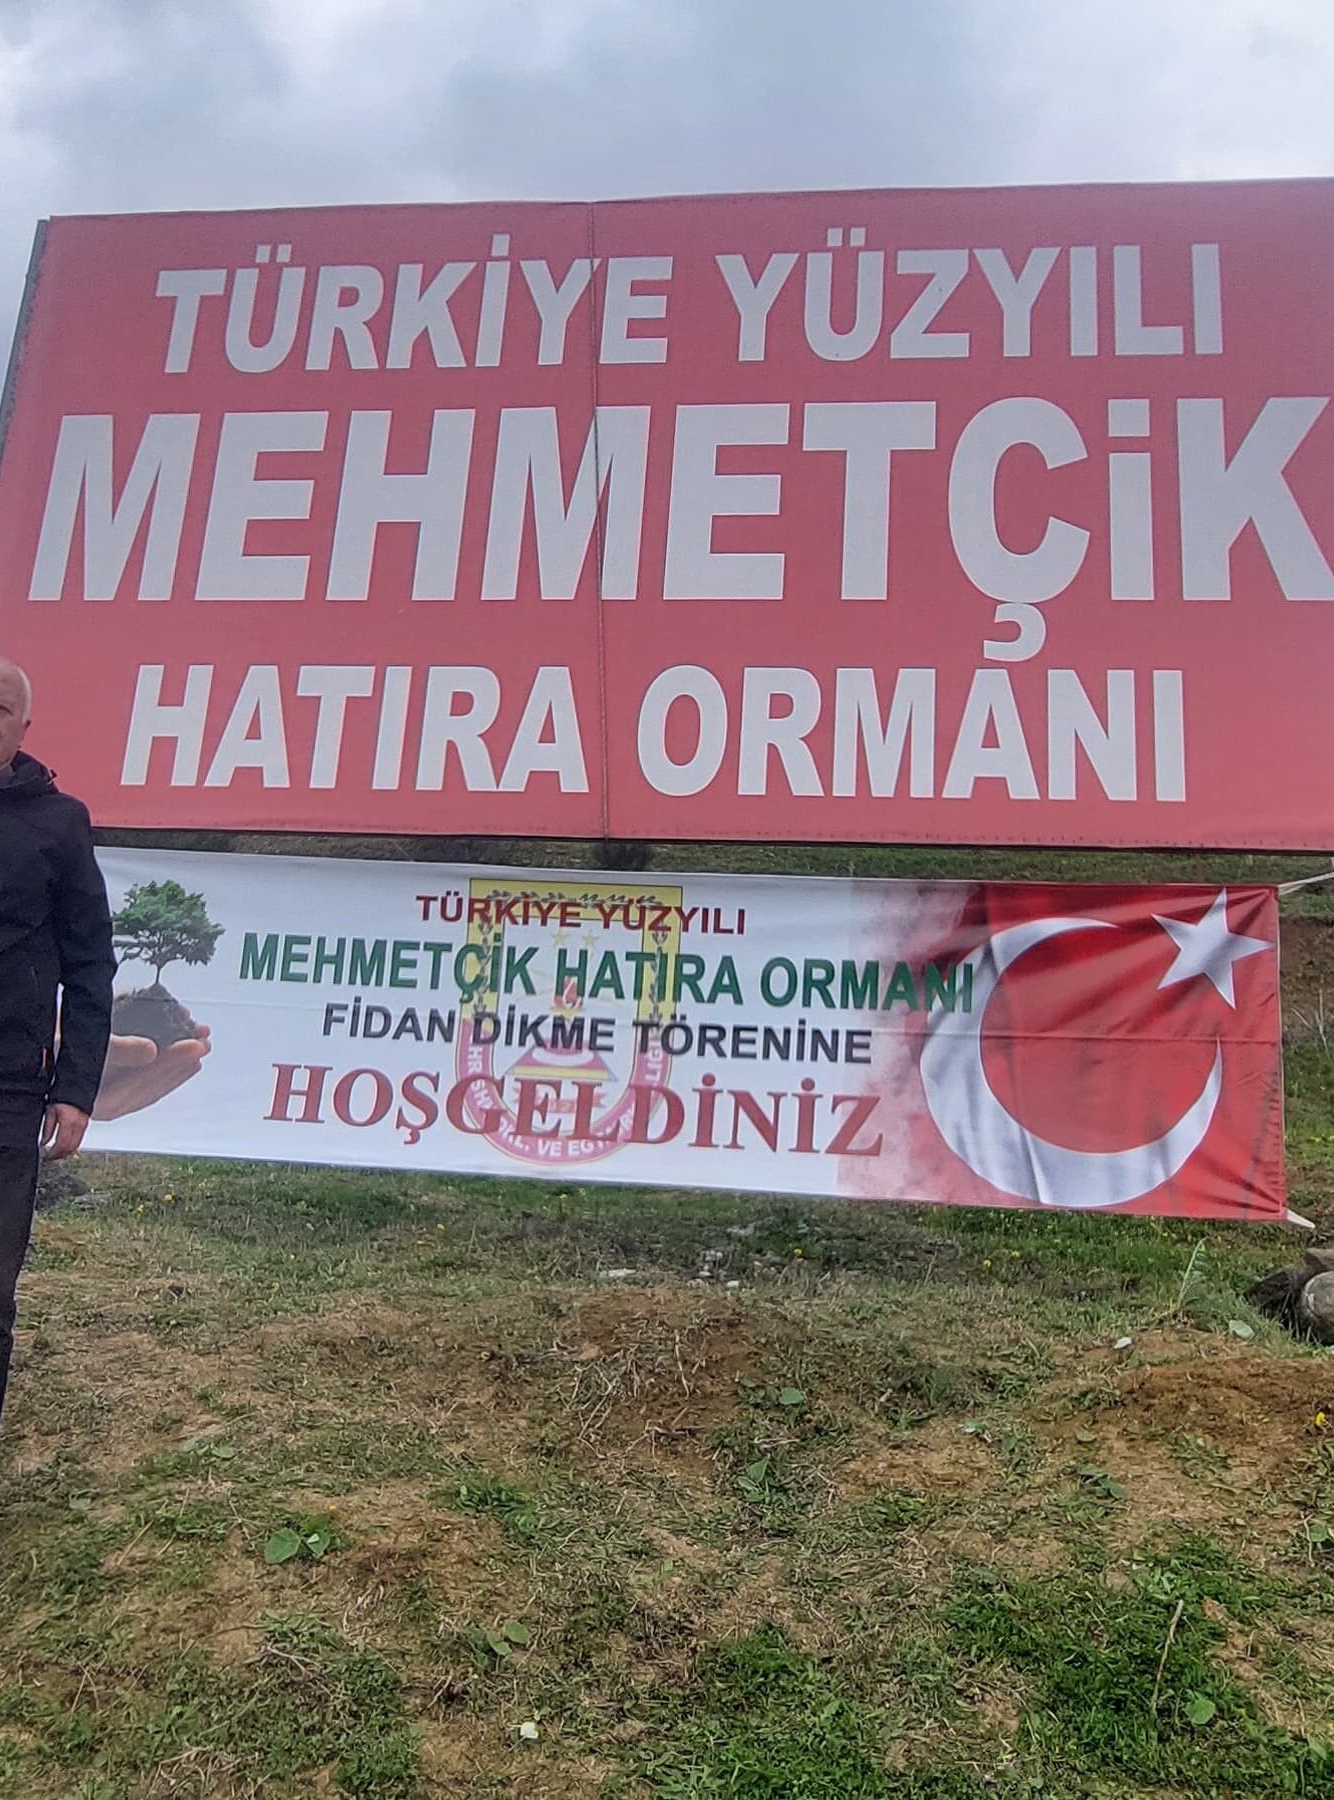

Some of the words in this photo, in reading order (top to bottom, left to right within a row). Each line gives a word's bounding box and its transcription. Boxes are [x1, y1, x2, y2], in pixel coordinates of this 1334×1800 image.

[155, 233, 673, 373] TÜRKİYE
[715, 226, 1224, 362] YÜZYILI
[119, 664, 590, 793] HATIRA
[636, 665, 1187, 802] ORMANI
[416, 890, 582, 928] TÜRKİYE
[596, 898, 746, 936] YÜZYILI
[238, 931, 540, 1004] MEHMETÇİK
[554, 947, 744, 1005] HATIRA
[759, 956, 973, 1013] ORMANI
[322, 996, 456, 1044] FİDAN
[470, 1005, 616, 1051] DİKME
[632, 1013, 873, 1065] TÖRENİNE
[263, 1063, 884, 1157] HOŞGELDİNİZ
[537, 1139, 563, 1158] VE
